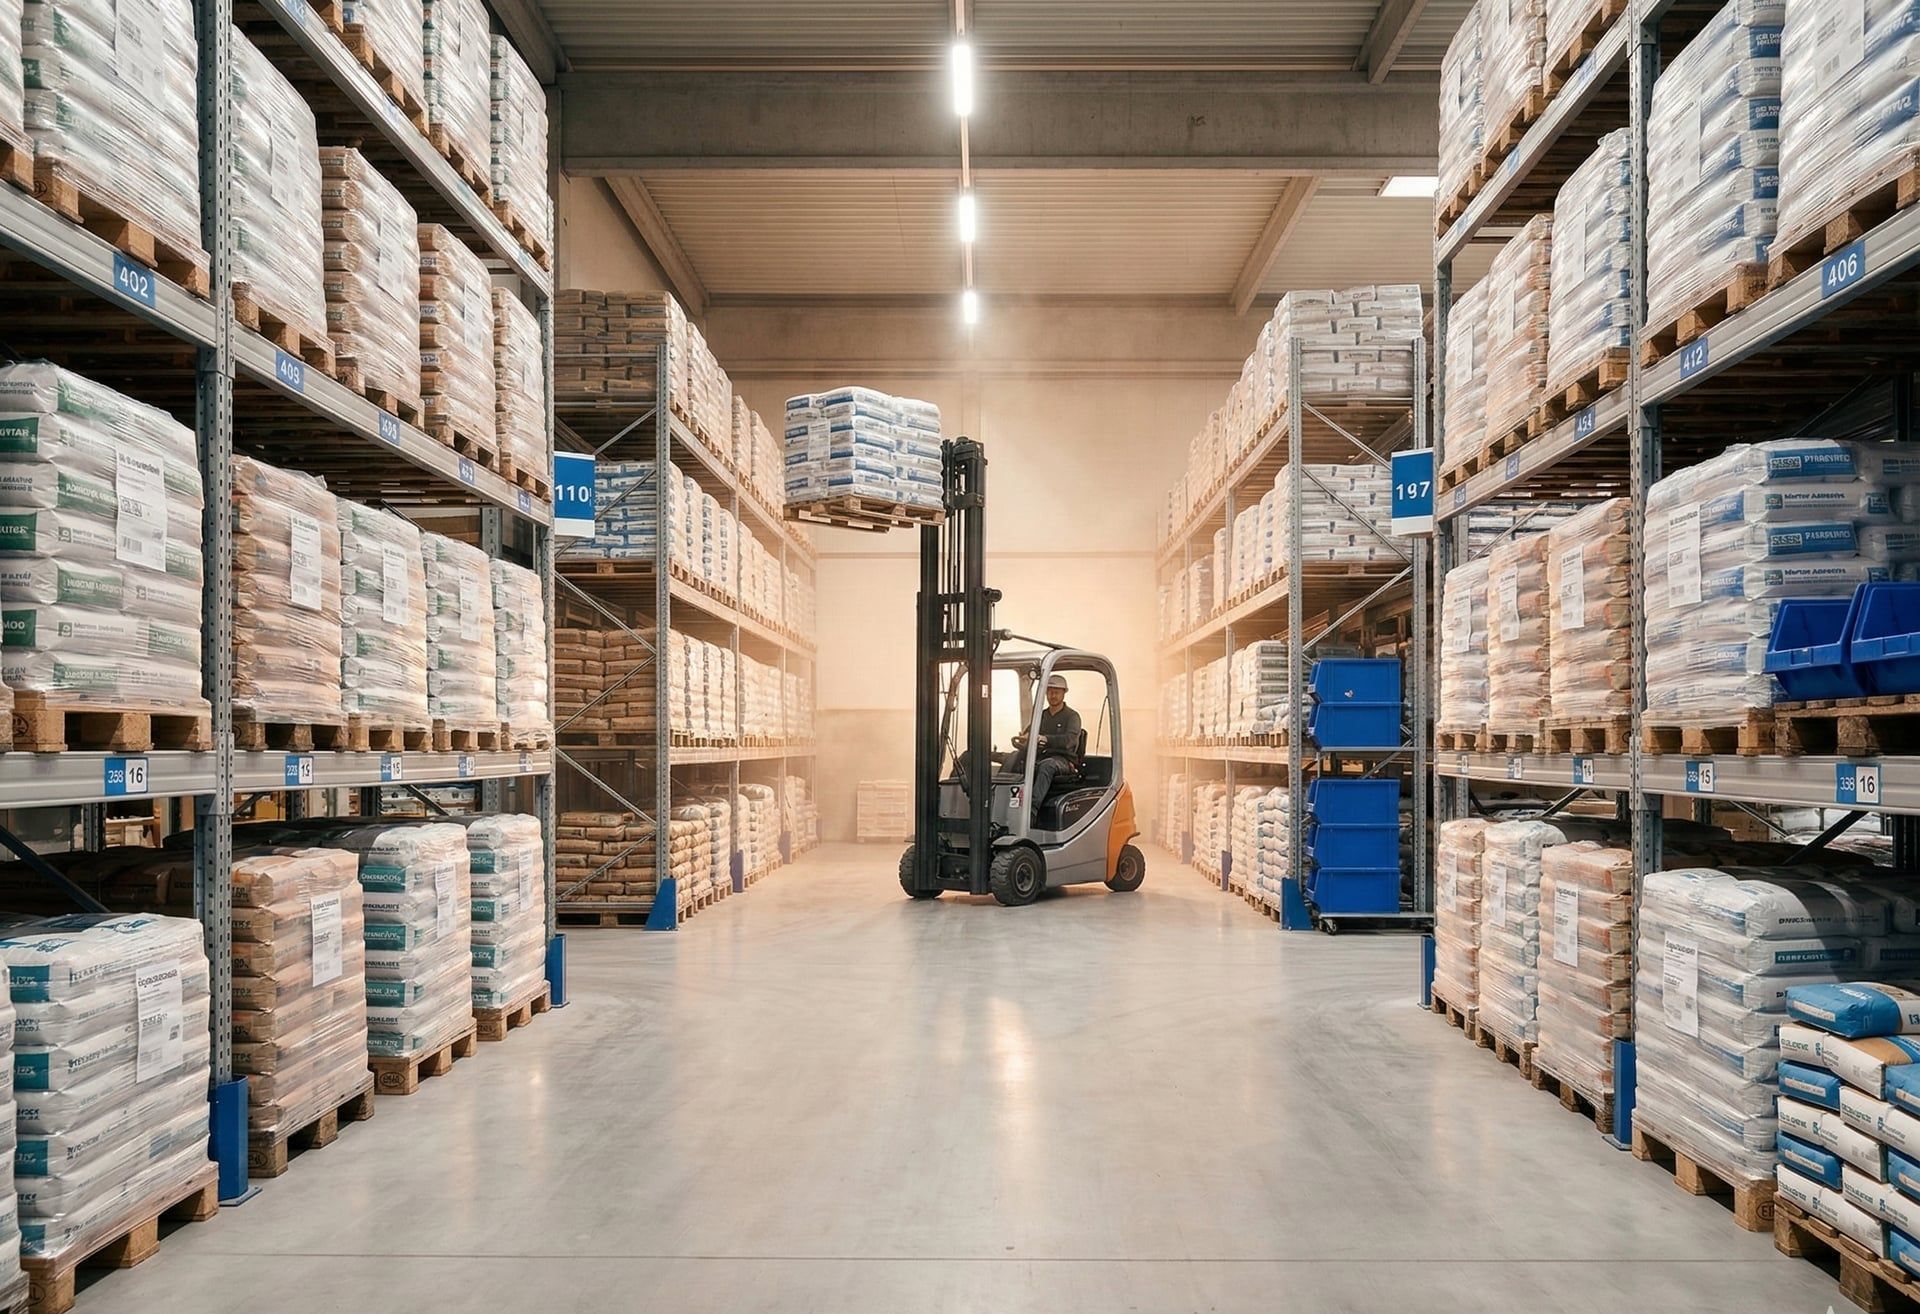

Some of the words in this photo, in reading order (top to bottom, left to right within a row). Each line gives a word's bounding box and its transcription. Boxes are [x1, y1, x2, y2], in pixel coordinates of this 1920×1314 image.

[1827, 253, 1857, 287] 406
[120, 266, 149, 298] 402
[1683, 345, 1703, 371] 412
[555, 484, 590, 502] 110
[1396, 480, 1430, 501] 197
[129, 766, 143, 784] 16
[1700, 769, 1711, 784] 15
[1859, 775, 1875, 794] 16
